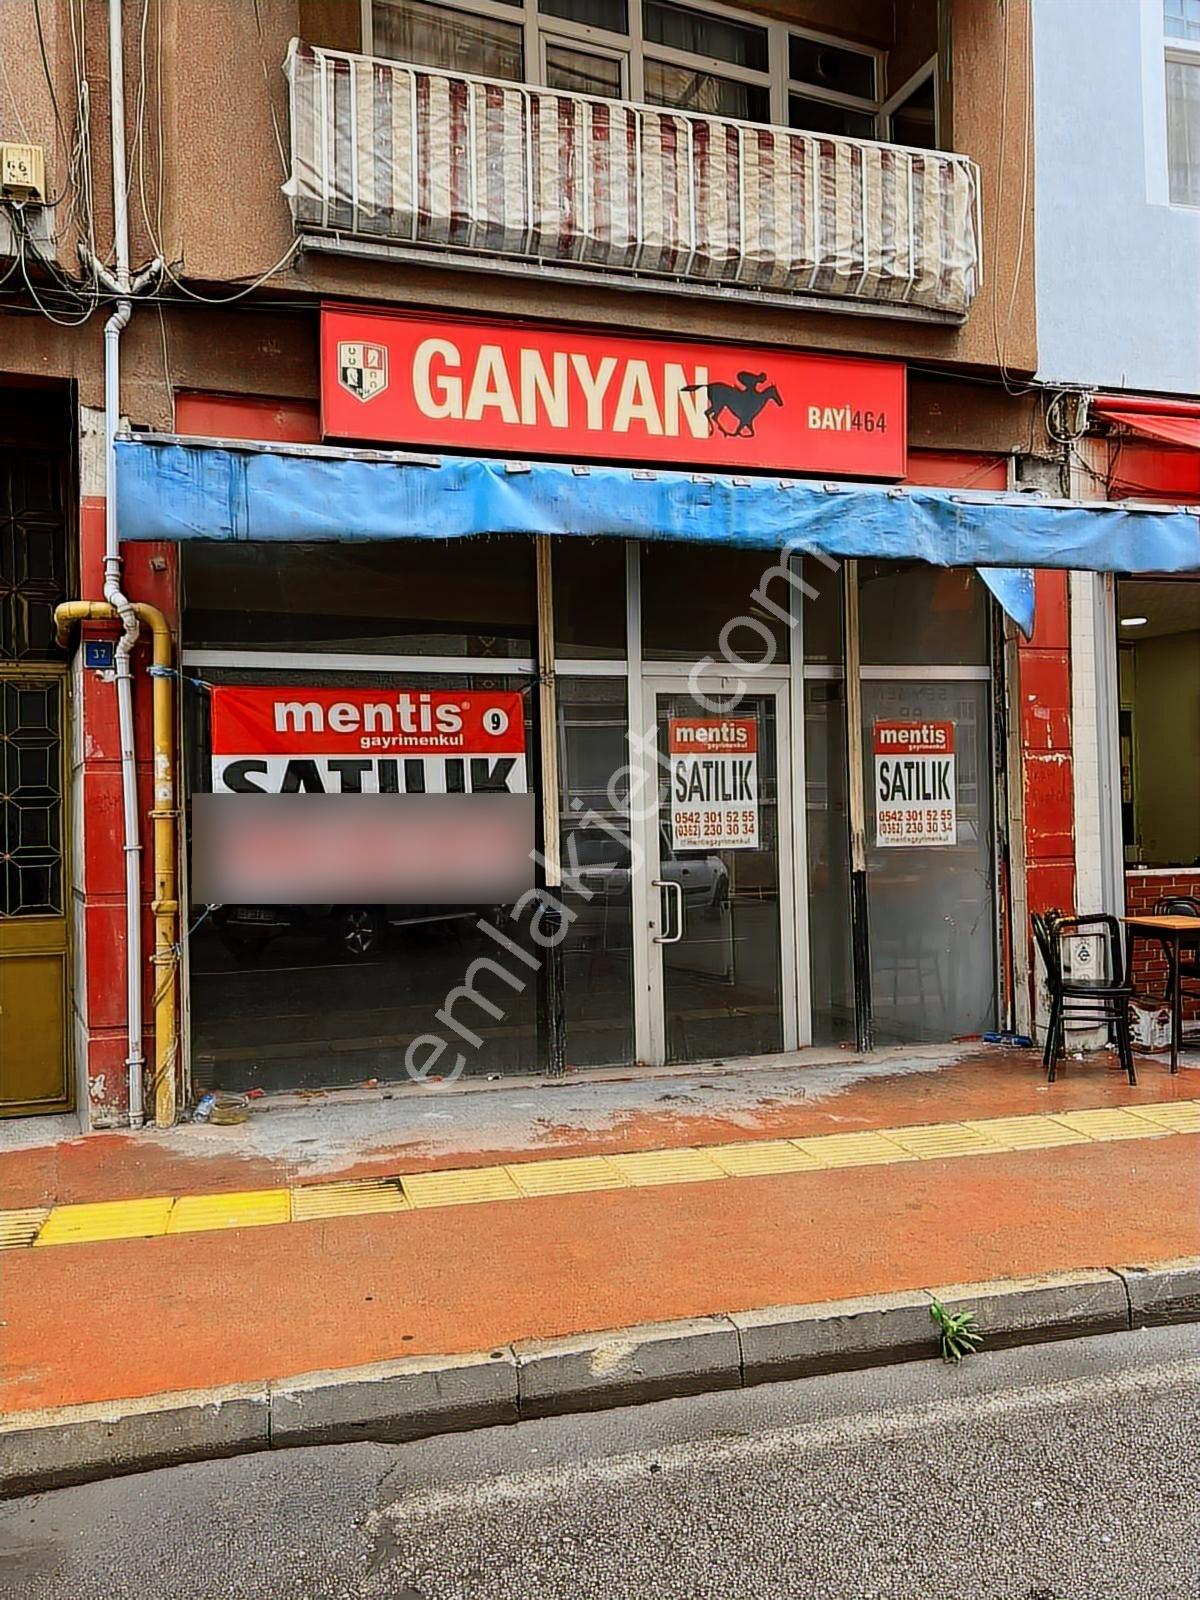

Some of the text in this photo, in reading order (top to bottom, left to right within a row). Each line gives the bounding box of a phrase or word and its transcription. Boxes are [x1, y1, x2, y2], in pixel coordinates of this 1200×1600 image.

[412, 337, 710, 440] GANYAN
[273, 693, 464, 733] mentis
[491, 713, 501, 730] 9
[360, 734, 464, 749] gayrimenkul
[675, 722, 748, 743] mentis
[880, 724, 946, 744] mentis
[675, 760, 754, 803] SATILIK
[879, 760, 951, 802] SATILIK
[675, 811, 755, 824] 0542 301 52 55
[879, 809, 953, 822] 0542 301 52 55
[704, 824, 723, 836] 230
[726, 824, 739, 835] 30
[742, 823, 755, 834] 34
[905, 822, 923, 834] 230
[926, 822, 938, 833] 30
[941, 821, 953, 833] 34
